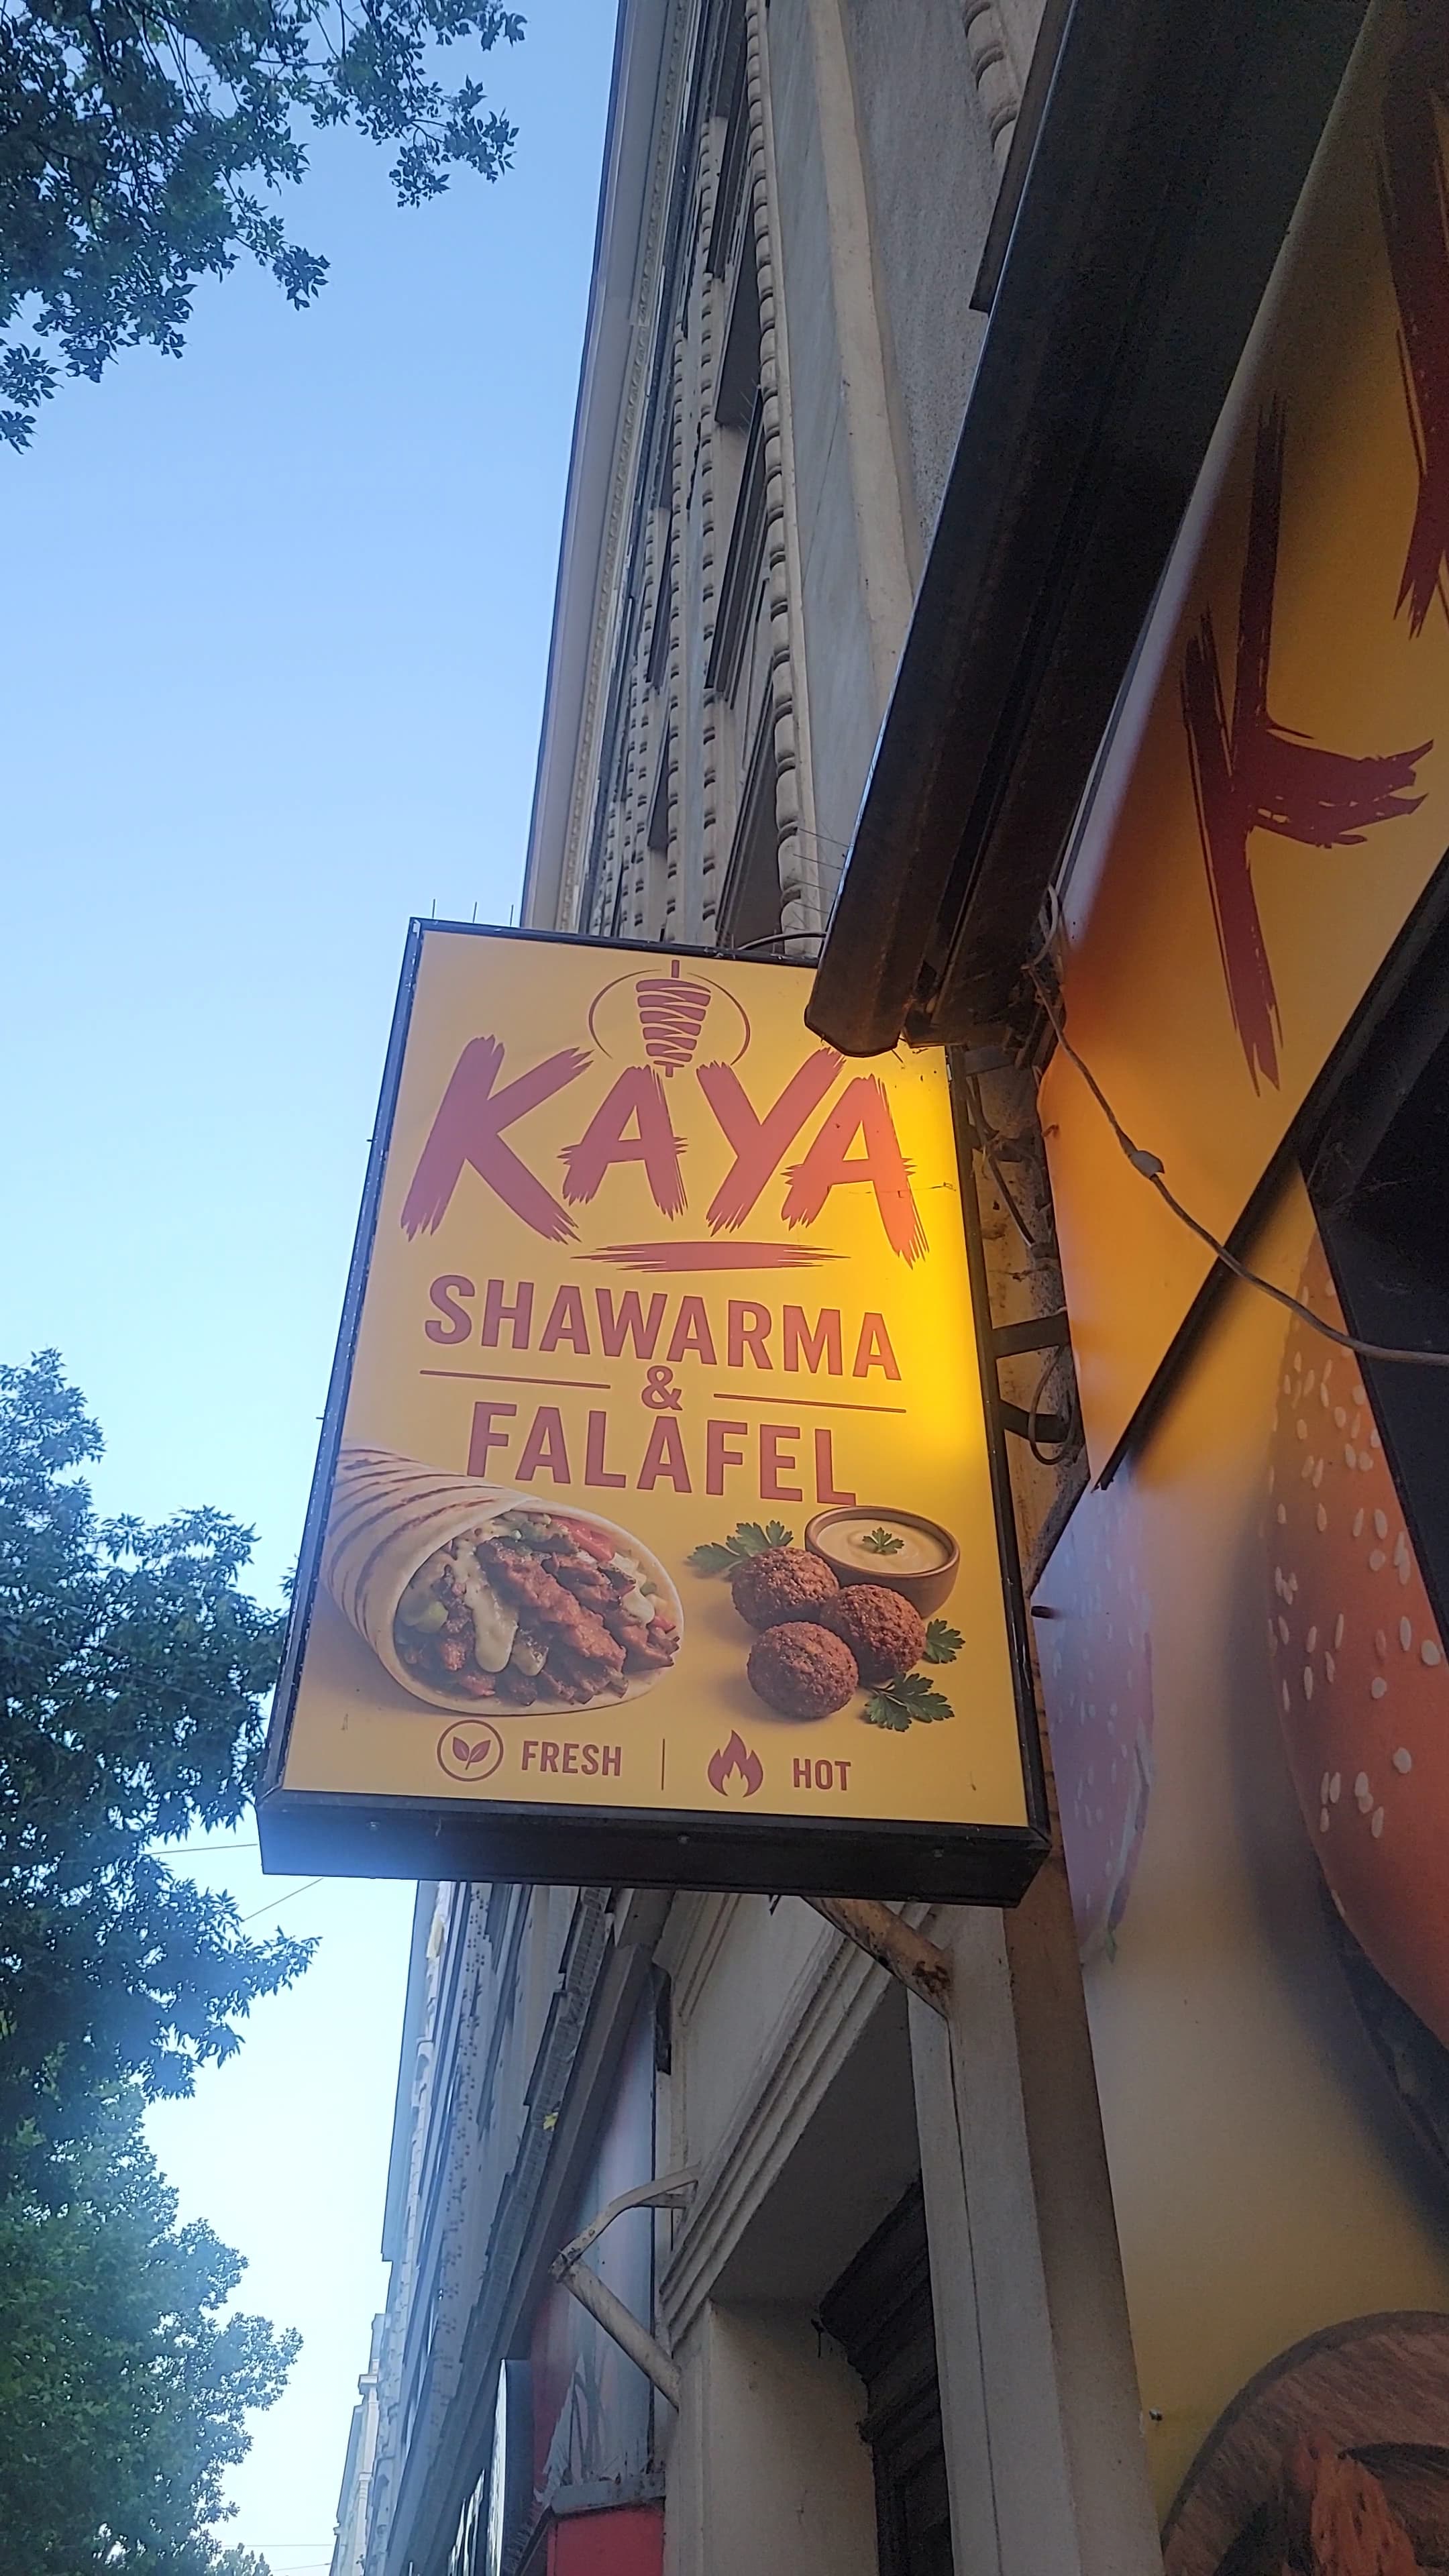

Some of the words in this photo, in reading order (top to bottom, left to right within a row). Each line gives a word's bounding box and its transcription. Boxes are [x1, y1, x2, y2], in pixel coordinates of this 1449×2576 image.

[401, 1035, 929, 1269] KAYA
[425, 1275, 902, 1381] SHAWARMA
[641, 1365, 682, 1411] &
[466, 1401, 857, 1505] FALAFEL
[521, 1741, 622, 1776] FRESH
[793, 1758, 851, 1791] HOT
